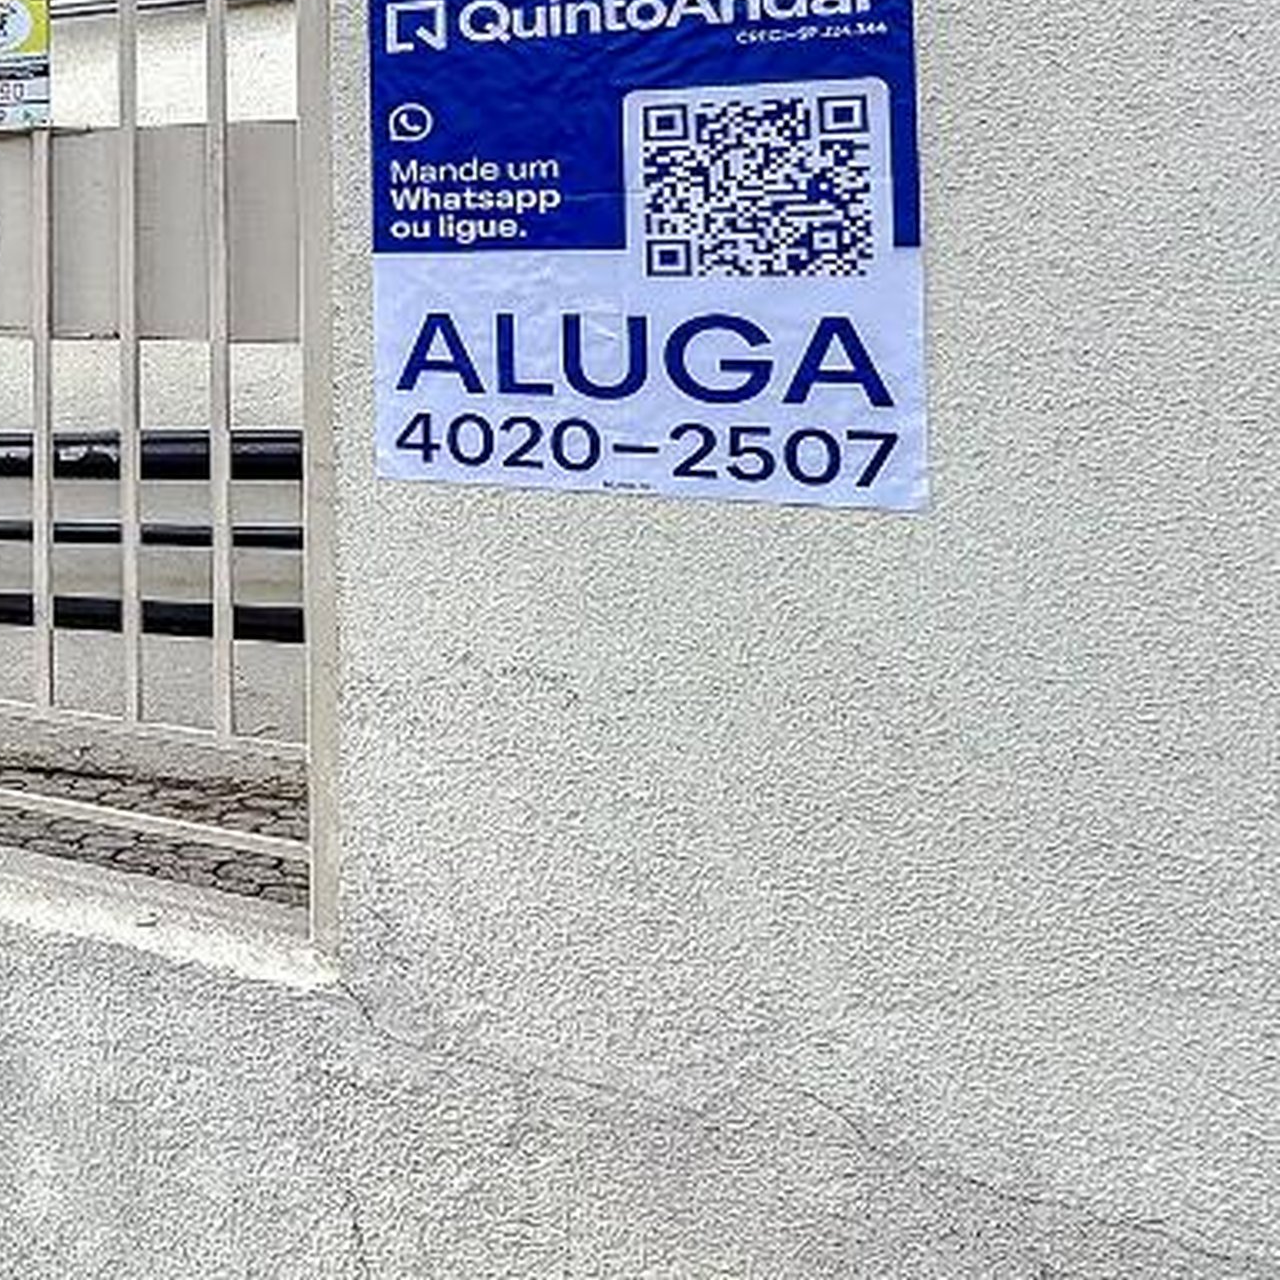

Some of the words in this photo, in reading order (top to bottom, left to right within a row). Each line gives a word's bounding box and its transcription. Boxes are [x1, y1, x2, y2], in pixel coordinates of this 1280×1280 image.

[390, 156, 499, 183] Mande
[507, 159, 559, 181] um
[390, 187, 561, 214] Whatsapp
[390, 220, 431, 238] ou
[438, 214, 527, 244] ligue.
[396, 314, 894, 407] ALUGA
